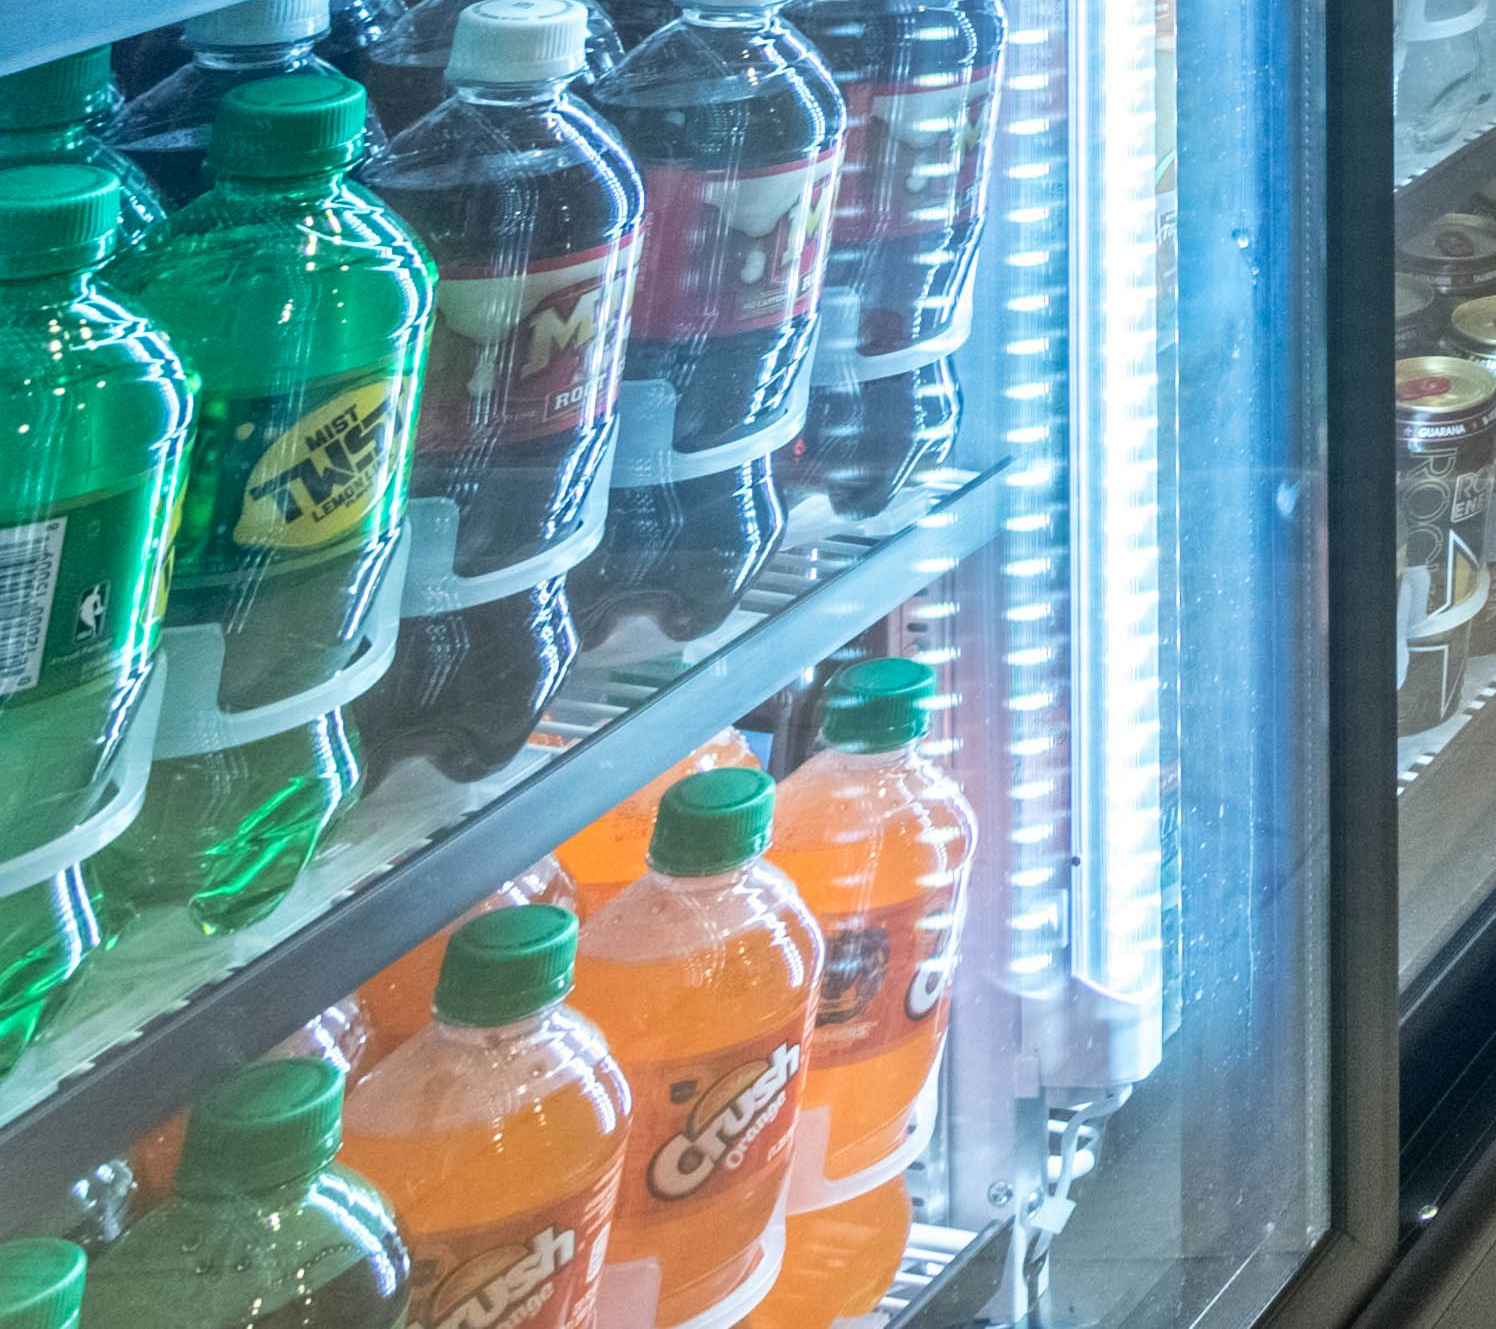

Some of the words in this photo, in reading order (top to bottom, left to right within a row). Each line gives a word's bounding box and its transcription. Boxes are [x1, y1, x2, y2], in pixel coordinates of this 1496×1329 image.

[303, 403, 358, 453] MIST
[1418, 424, 1467, 438] GUARANA
[651, 1041, 801, 1196] Crush
[725, 1090, 786, 1170] Orange
